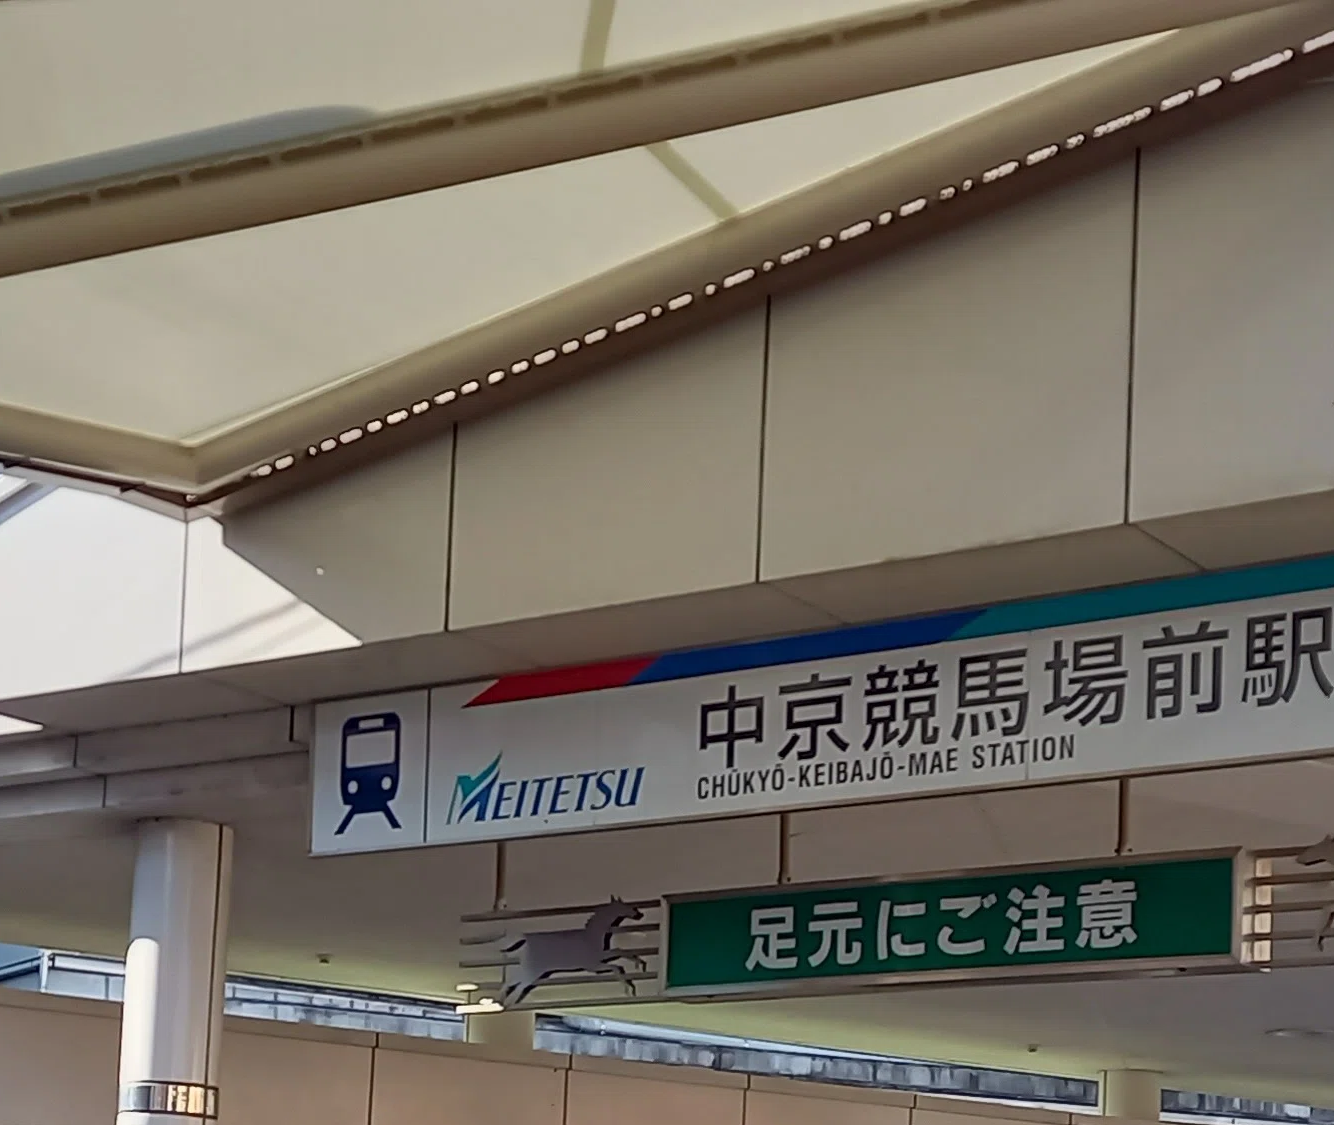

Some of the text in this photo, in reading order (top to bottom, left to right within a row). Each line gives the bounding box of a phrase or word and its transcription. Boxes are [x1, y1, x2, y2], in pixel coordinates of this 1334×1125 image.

[699, 606, 1334, 768] 中京競馬場前駅
[445, 750, 645, 825] MEITETSU
[972, 734, 1075, 769] STATION
[744, 879, 1138, 971] 足元にご注意
